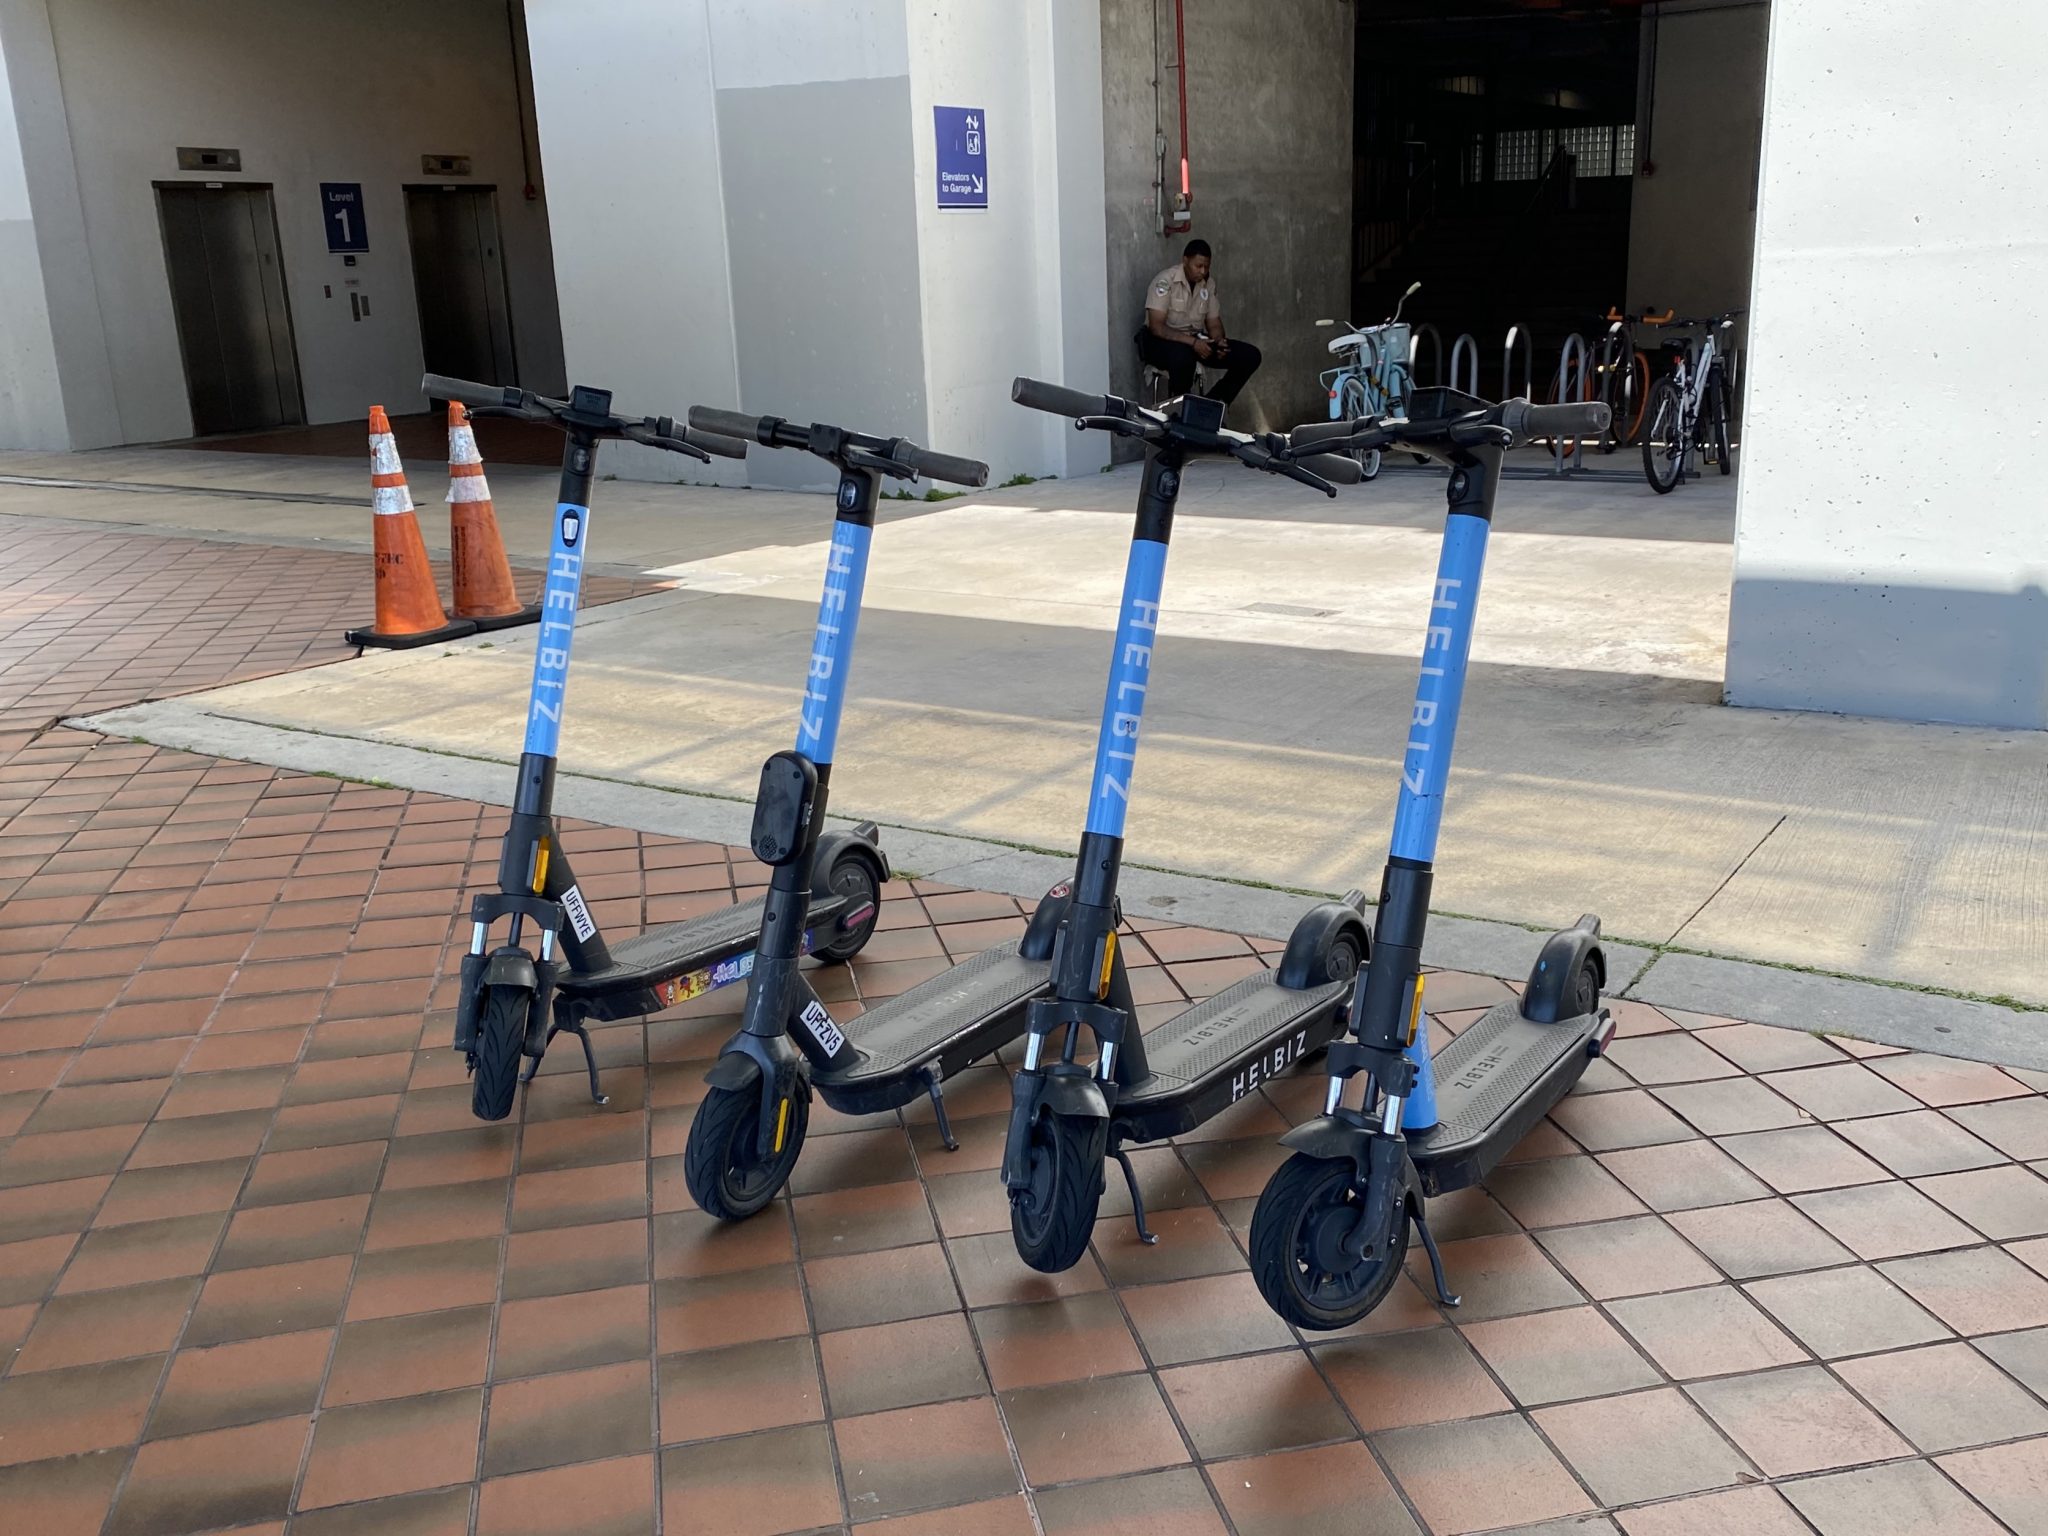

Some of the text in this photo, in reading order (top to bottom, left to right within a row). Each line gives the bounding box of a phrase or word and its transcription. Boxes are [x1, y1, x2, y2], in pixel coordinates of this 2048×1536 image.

[941, 171, 970, 181] Elevators
[942, 183, 972, 195] to Garage
[329, 192, 355, 202] Level
[335, 208, 352, 243] 1
[533, 551, 580, 724] HELBIZ
[1101, 598, 1159, 803] HELBIZ
[565, 890, 592, 938] UFFWYE
[1182, 1015, 1238, 1046] HELBIZ
[1232, 1030, 1307, 1103] HELBIZ
[1453, 1055, 1503, 1089] HELBIZ
